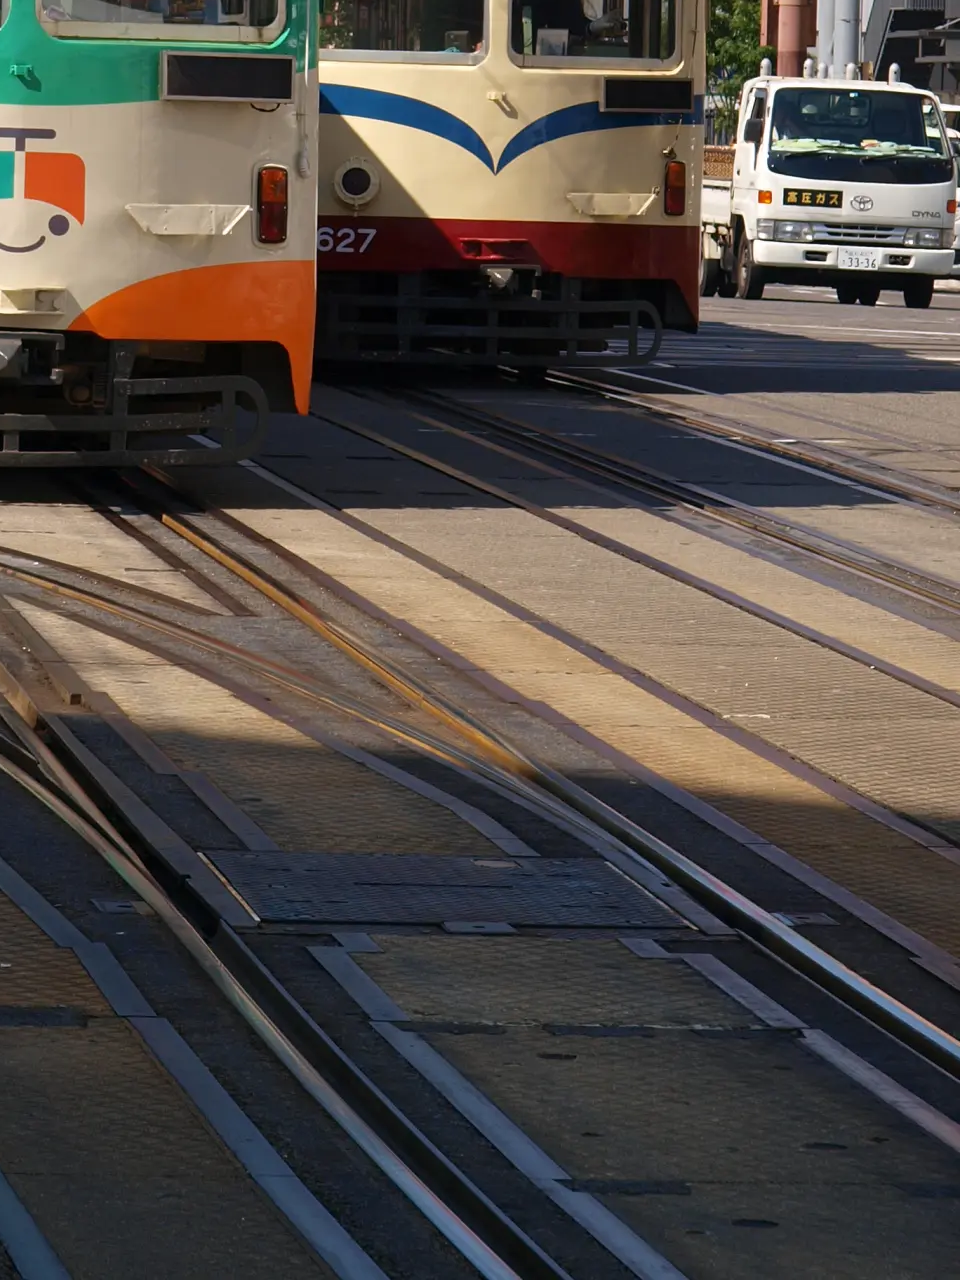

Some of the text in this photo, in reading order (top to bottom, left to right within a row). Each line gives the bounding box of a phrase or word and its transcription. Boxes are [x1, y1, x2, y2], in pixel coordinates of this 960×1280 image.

[787, 191, 839, 205] 高圧ガス
[911, 210, 941, 219] DYNA
[317, 226, 377, 253] 627
[848, 257, 876, 268] 33-36
